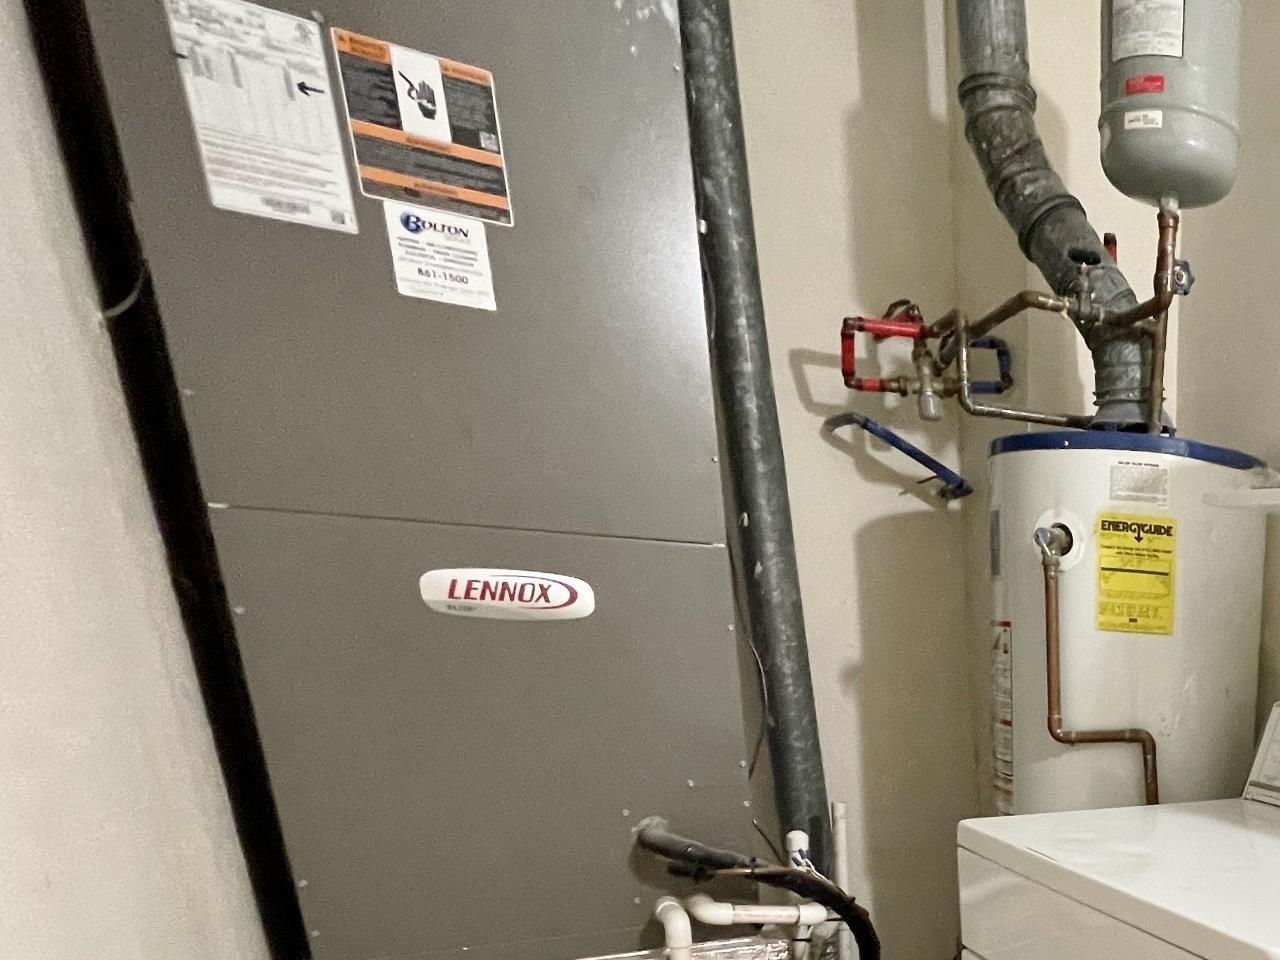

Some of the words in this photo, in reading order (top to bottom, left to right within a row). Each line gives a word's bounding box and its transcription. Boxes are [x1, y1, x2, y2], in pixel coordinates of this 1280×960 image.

[405, 214, 469, 238] BOLTON
[417, 267, 469, 285] 861-1500
[1101, 520, 1173, 537] ENERGYGUIDE
[447, 578, 552, 604] LENNOX
